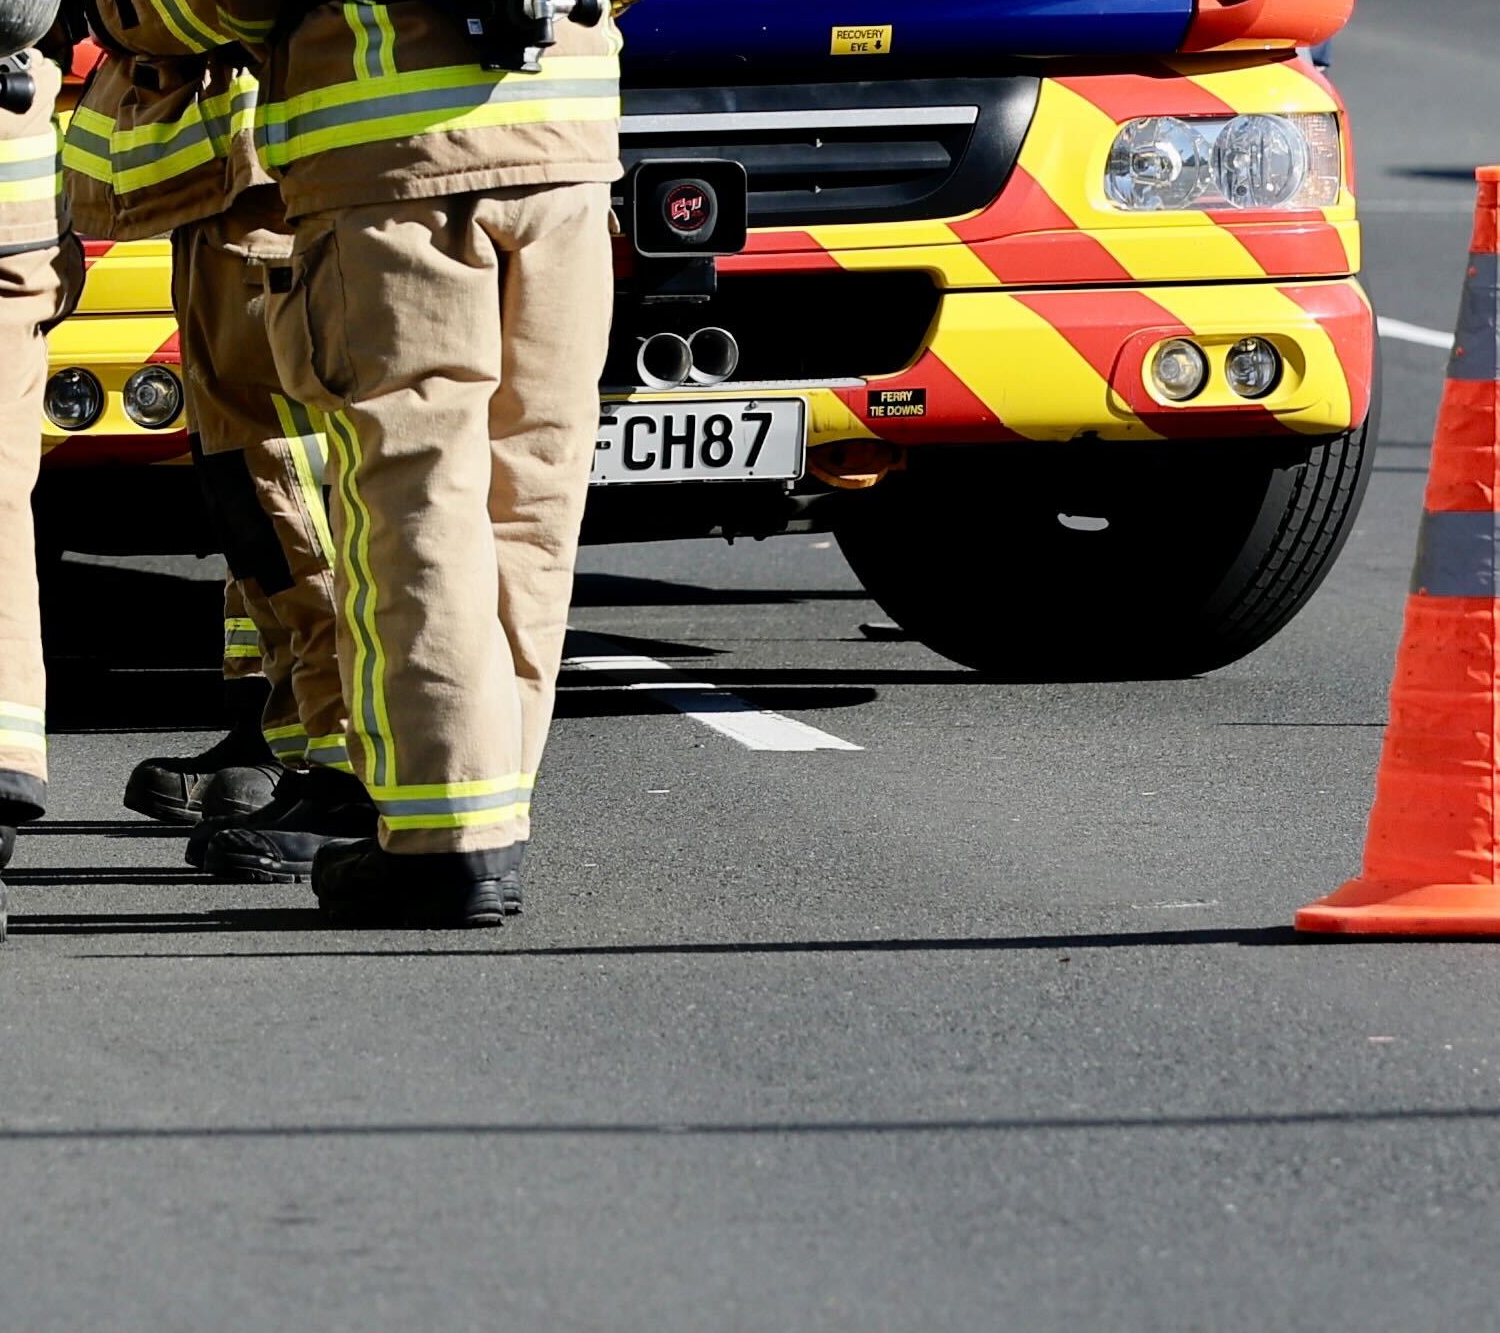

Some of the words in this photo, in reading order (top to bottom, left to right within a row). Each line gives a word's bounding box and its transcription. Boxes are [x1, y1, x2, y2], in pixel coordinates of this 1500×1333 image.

[837, 28, 884, 40] RECOVERY
[851, 42, 868, 52] EYE
[881, 391, 913, 402] FERRY
[870, 405, 885, 417] TIE
[887, 404, 924, 416] DOWNS
